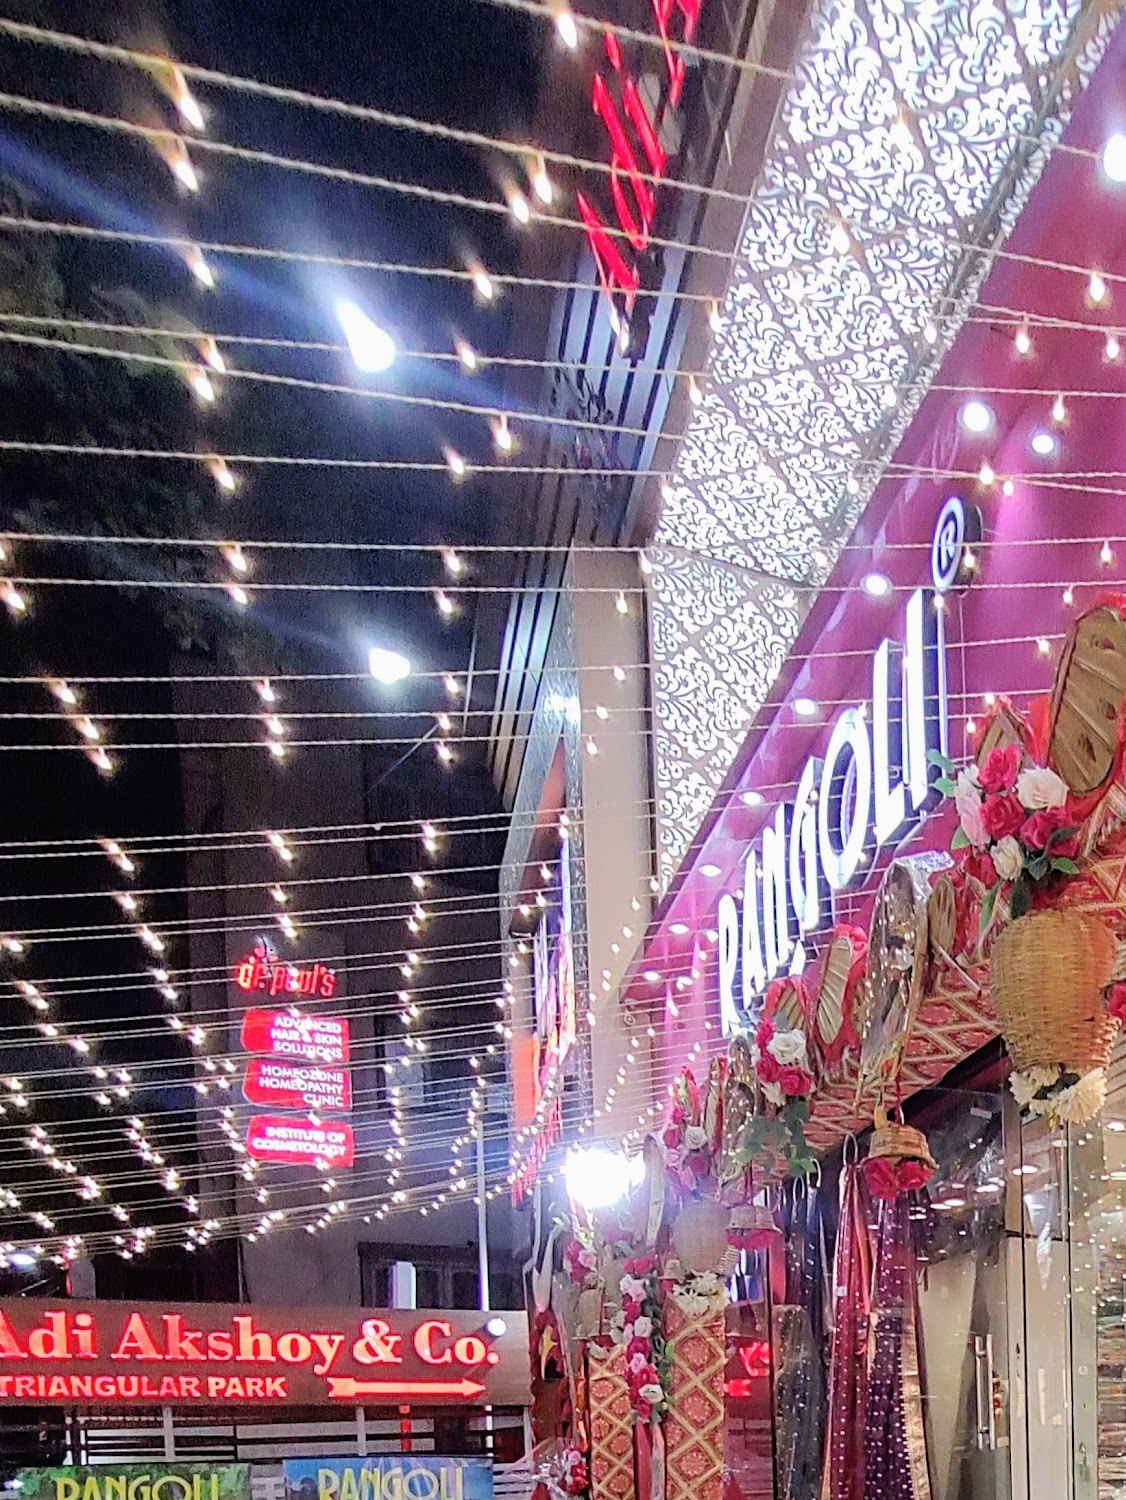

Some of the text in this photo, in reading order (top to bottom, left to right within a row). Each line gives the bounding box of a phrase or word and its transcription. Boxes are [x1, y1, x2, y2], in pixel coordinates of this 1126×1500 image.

[270, 1028, 301, 1041] HAIR
[314, 1033, 342, 1046] SKIN
[273, 1041, 343, 1059] SOLUTIONS
[259, 1077, 343, 1094] HOMEOPATHY
[303, 1093, 344, 1107] CLINIC
[110, 1312, 345, 1376] Akshoy
[352, 1318, 403, 1364] &
[413, 1320, 500, 1365] Co.
[0, 1375, 288, 1398] TRIANGULAR PARK
